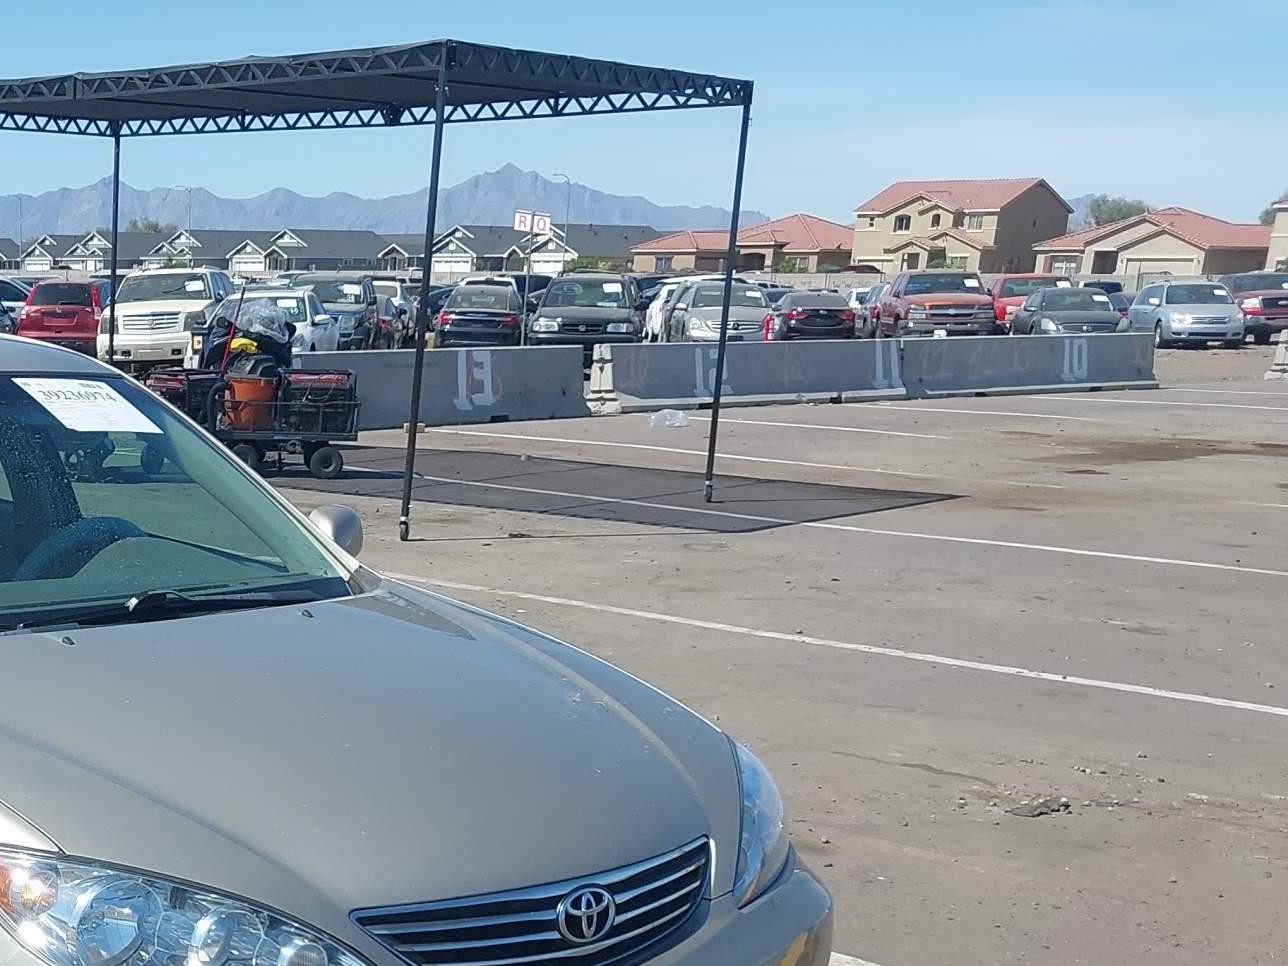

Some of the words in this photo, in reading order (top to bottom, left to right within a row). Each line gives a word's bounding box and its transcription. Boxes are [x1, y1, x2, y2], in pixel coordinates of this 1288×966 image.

[518, 215, 527, 229] R
[871, 338, 903, 389] 11
[1061, 338, 1089, 382] 10
[37, 389, 118, 403] 39236974
